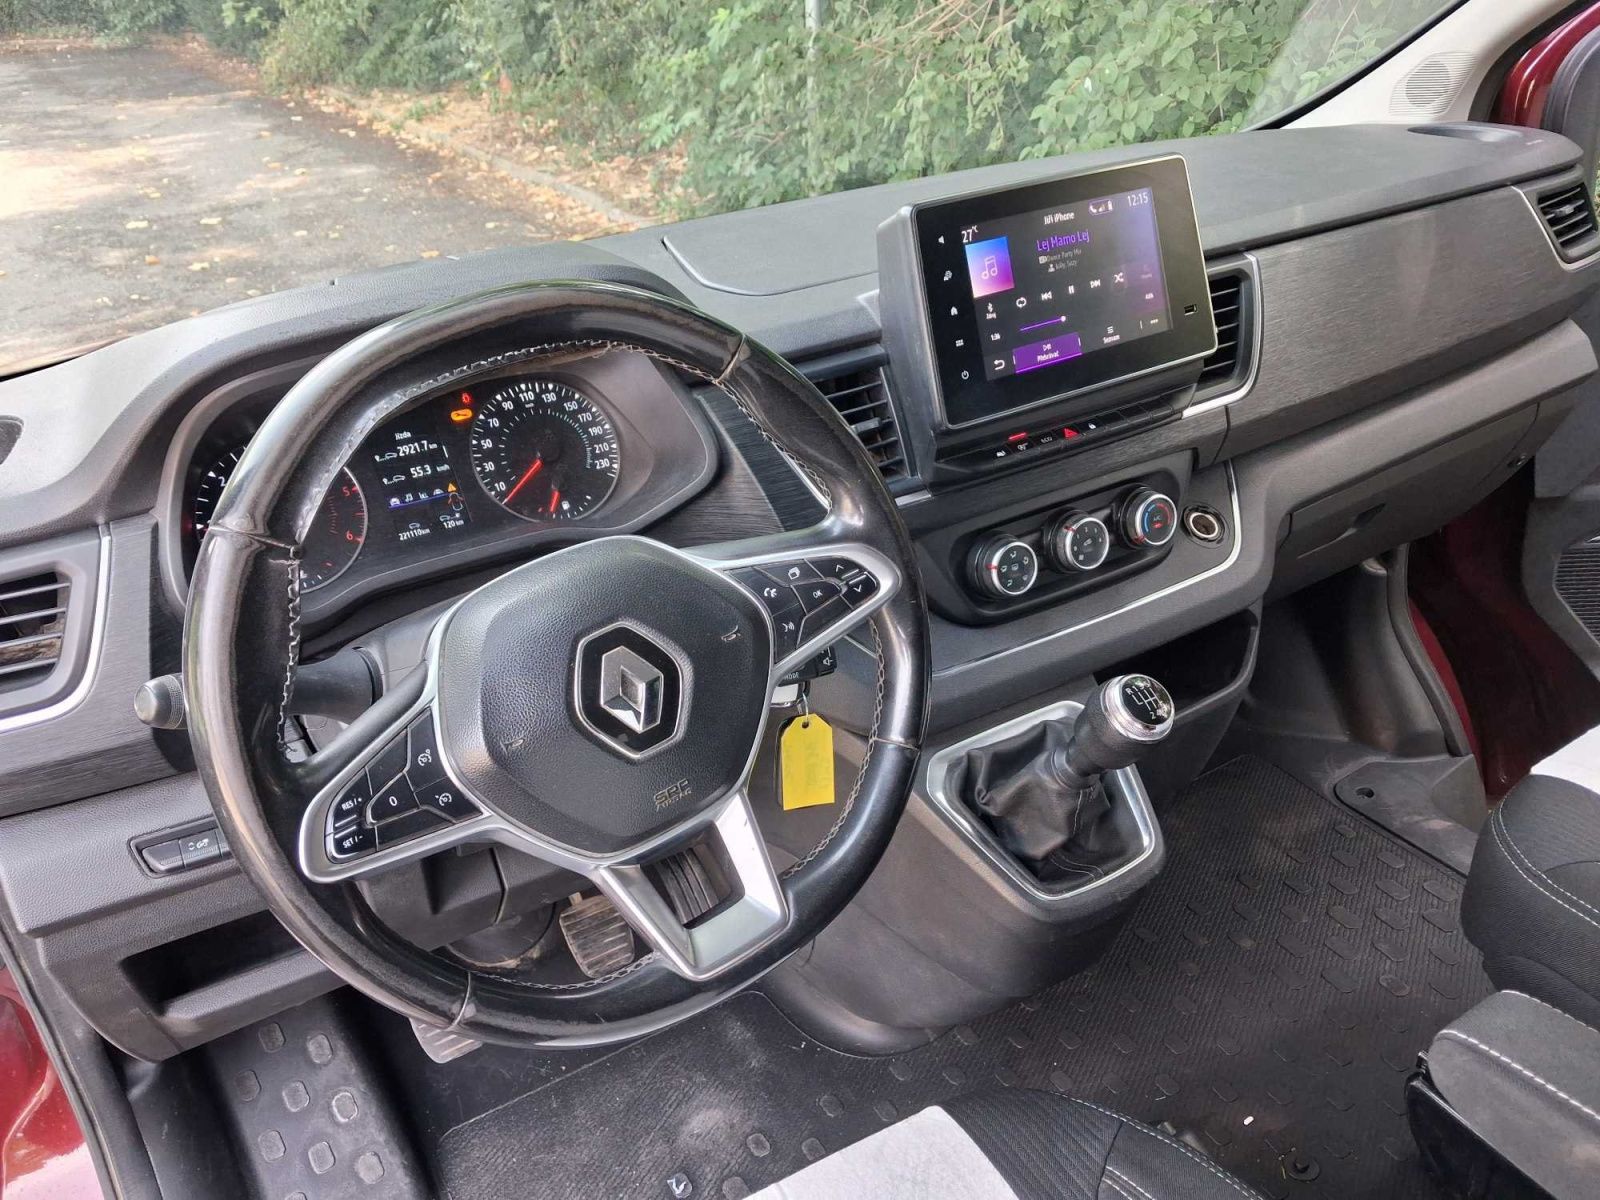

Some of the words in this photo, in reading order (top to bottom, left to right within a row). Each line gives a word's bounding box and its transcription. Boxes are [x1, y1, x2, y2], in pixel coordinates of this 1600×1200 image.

[1127, 191, 1149, 207] 12:15
[1054, 211, 1075, 222] iPhone
[1037, 238, 1050, 252] Lej
[1051, 233, 1076, 247] Mamo
[1077, 229, 1090, 243] Lej
[519, 391, 535, 402] 110
[541, 393, 557, 403] 130
[502, 401, 513, 411] 90
[563, 401, 578, 412] 150
[488, 418, 500, 428] 70
[577, 412, 592, 423] 170
[588, 426, 603, 437] 190
[397, 440, 428, 457] 2921.7
[480, 439, 493, 450] 50
[593, 443, 609, 454] 210
[482, 461, 495, 473] 30
[594, 458, 610, 470] 230
[410, 464, 432, 479] 55.3
[342, 487, 350, 497] 5
[494, 481, 507, 492] 10
[443, 520, 456, 530] 120
[346, 531, 353, 541] 6
[813, 590, 823, 599] OK
[1149, 711, 1157, 720] 2
